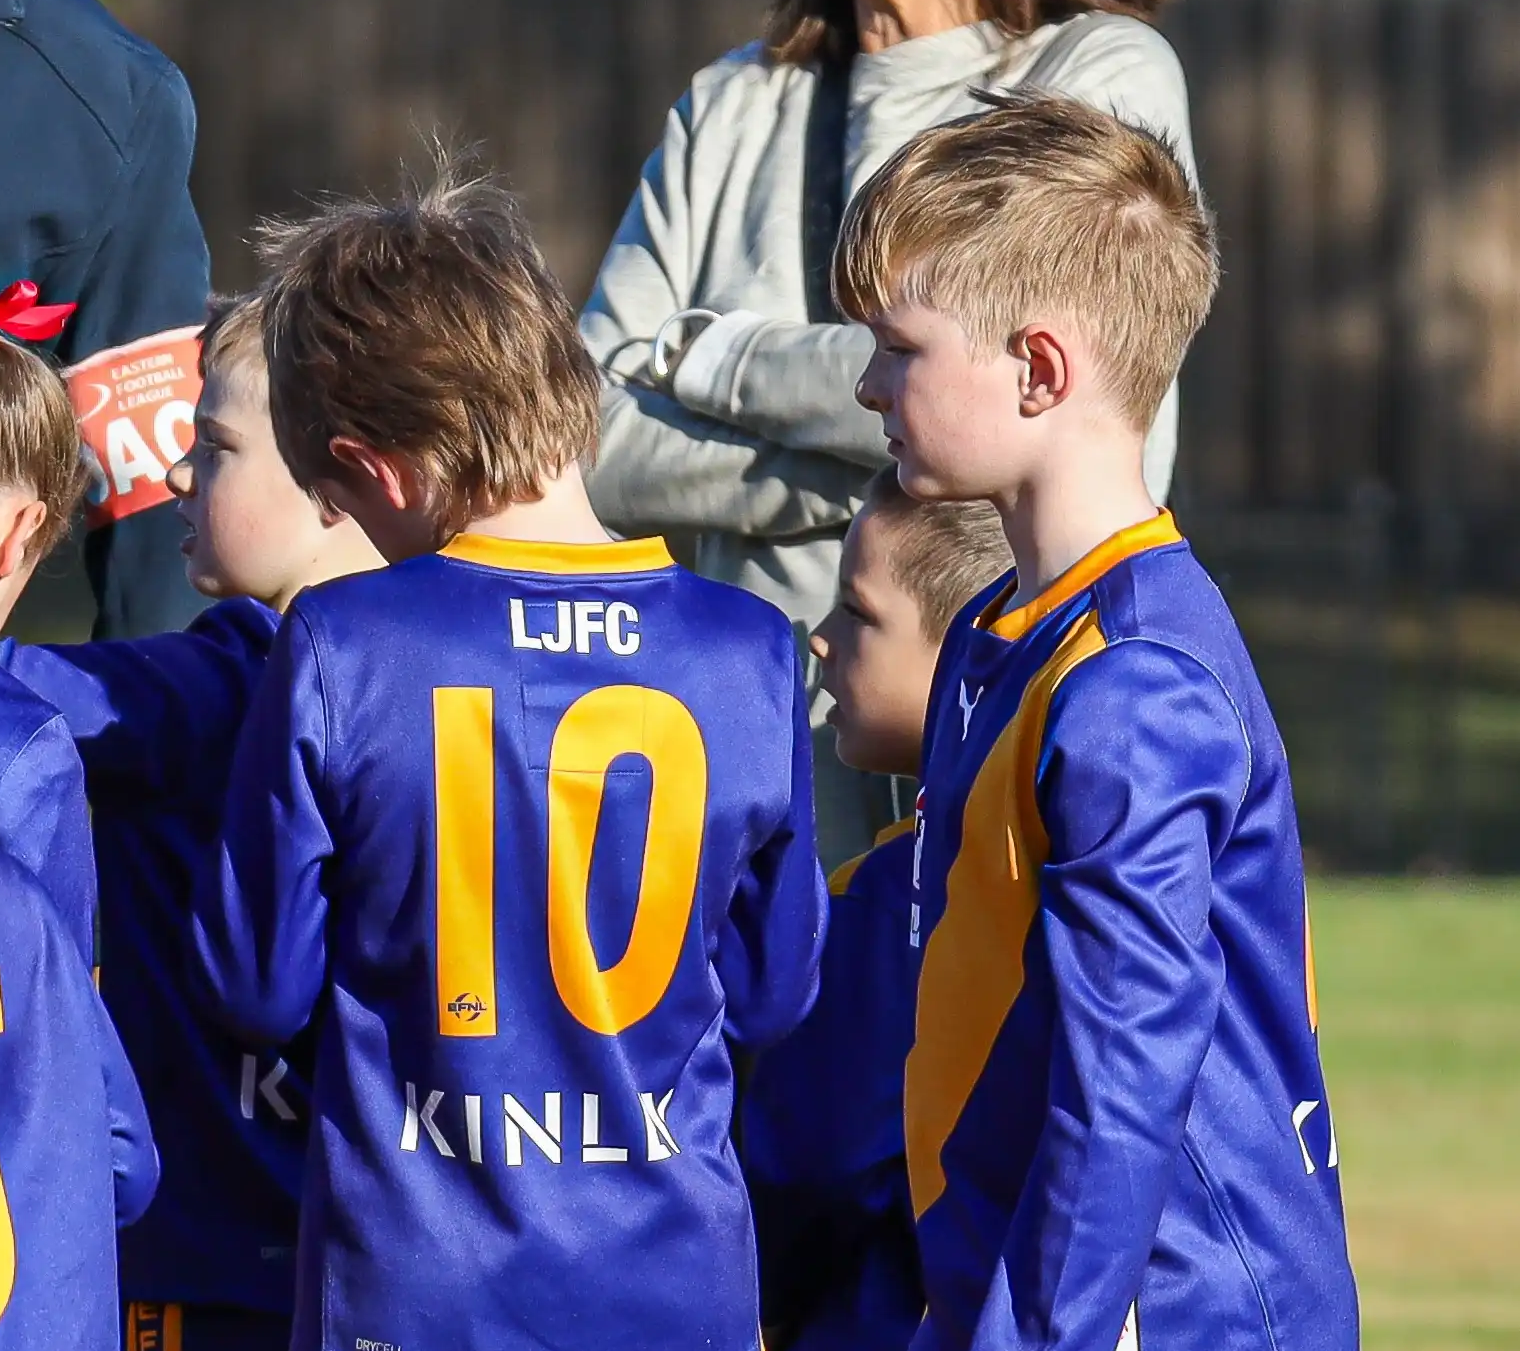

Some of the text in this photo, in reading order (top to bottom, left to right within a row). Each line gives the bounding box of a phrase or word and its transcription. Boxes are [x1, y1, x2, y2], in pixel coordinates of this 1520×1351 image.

[111, 352, 175, 380] EASTERN
[115, 366, 186, 396] FOOTBALL
[118, 385, 174, 411] LEAGUE
[81, 399, 198, 504] AC
[509, 597, 640, 656] LJFC
[432, 685, 708, 1037] 10
